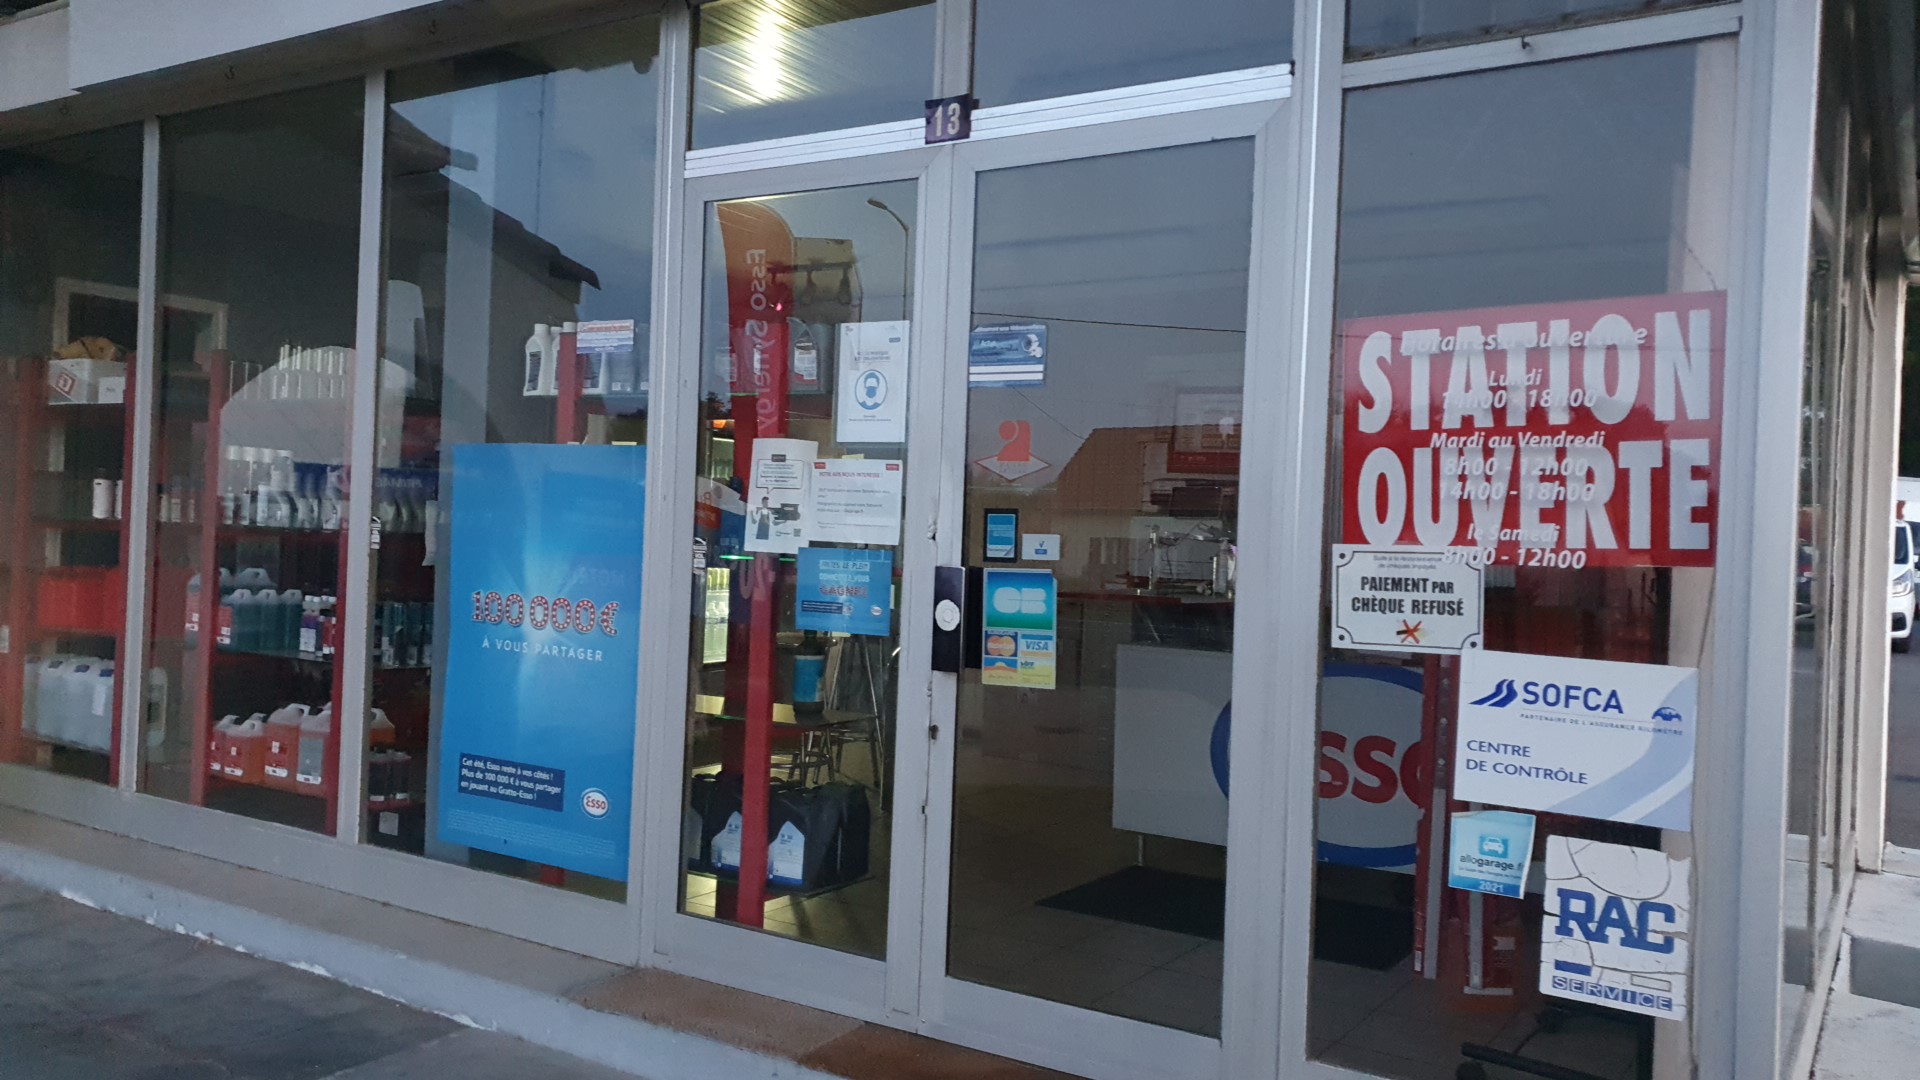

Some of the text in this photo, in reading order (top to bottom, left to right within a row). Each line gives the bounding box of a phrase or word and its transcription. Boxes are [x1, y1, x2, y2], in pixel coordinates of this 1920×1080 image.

[935, 102, 961, 137] 13
[1358, 309, 1711, 434] STATION
[1431, 431, 1606, 449] Mardi au Vendredi
[1443, 456, 1499, 477] 8h00
[1521, 455, 1589, 477] 12h00
[1357, 438, 1710, 550] OUVERTE
[1441, 480, 1507, 501] 14h00
[1526, 480, 1596, 501] 18h00
[1488, 524, 1560, 542] Samedi
[1442, 546, 1496, 566] 8h00
[1518, 547, 1586, 569] 12h00
[1361, 576, 1454, 594] PAIEMENT PAR
[1351, 594, 1464, 616] CHÈQUE REFUSÉ
[496, 638, 528, 653] VOUS
[535, 645, 603, 662] PARTAGER
[1025, 641, 1049, 651] VISA
[1522, 681, 1624, 714] SOFCA
[1466, 740, 1532, 758] CENTRE
[487, 761, 501, 771] Esso
[1465, 759, 1588, 785] DE CONTRÔLE
[461, 768, 475, 778] Plus
[475, 770, 484, 780] de
[485, 772, 497, 781] 100
[520, 780, 535, 789] vous
[535, 783, 562, 795] partager
[585, 795, 607, 810] Esso
[1479, 880, 1505, 893] 2021
[1555, 887, 1676, 954] RAC
[1553, 975, 1673, 1011] SERVICE
